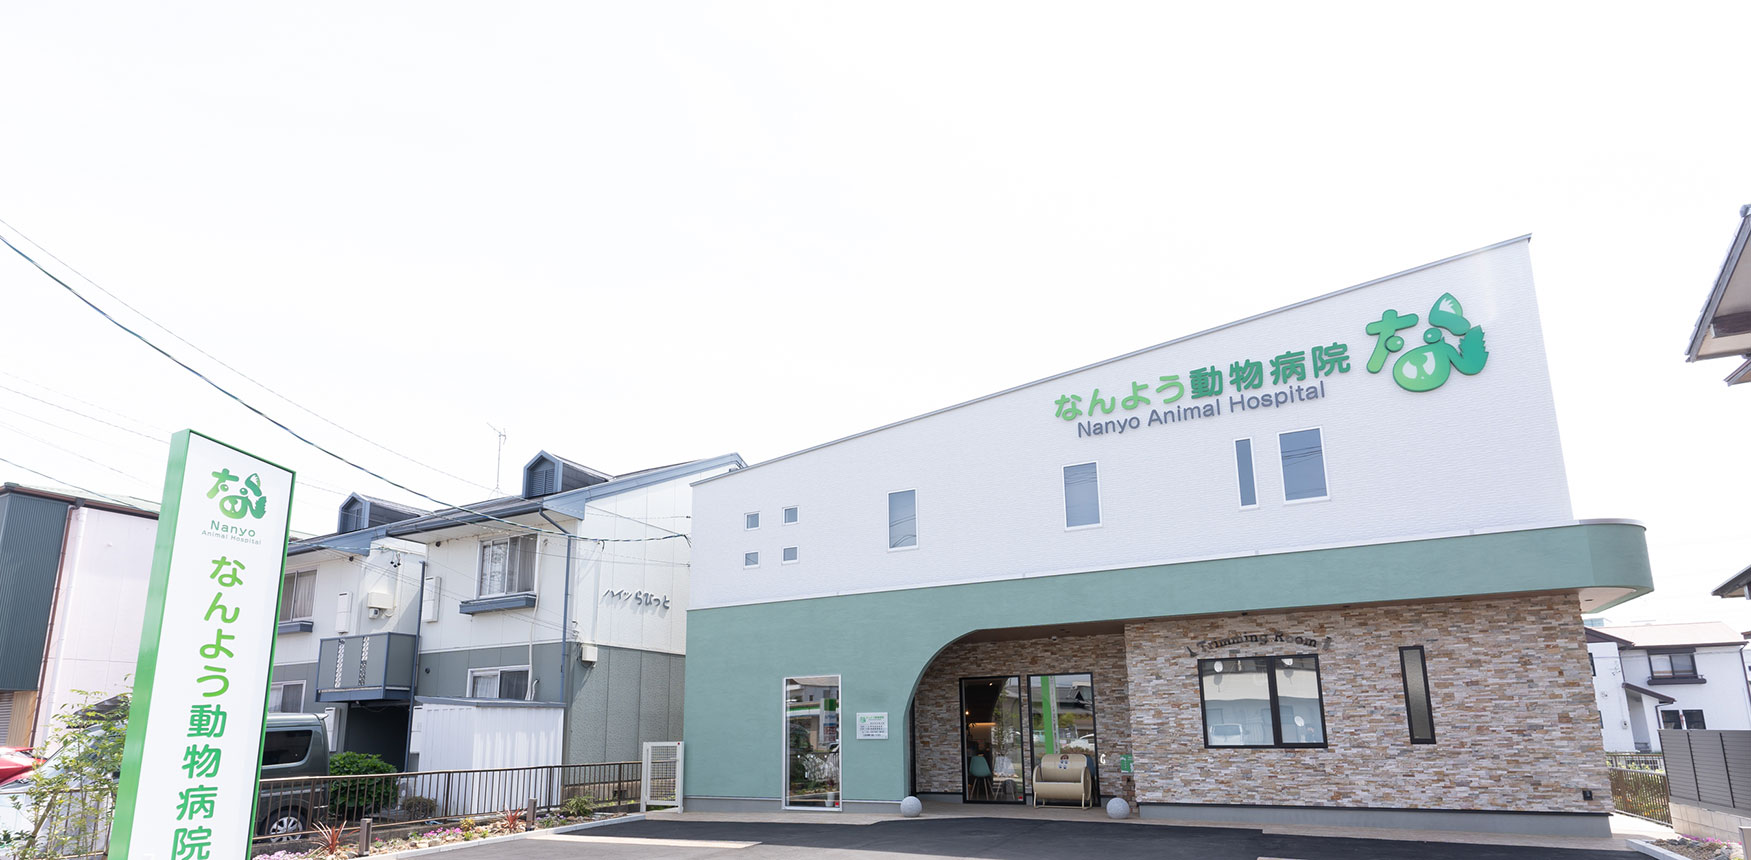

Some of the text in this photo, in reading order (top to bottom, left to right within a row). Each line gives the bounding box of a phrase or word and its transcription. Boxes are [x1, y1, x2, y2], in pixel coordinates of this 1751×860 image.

[1054, 341, 1352, 422] なんよう動物病院
[1077, 380, 1326, 439] Nanyo Animal Hospital
[201, 529, 262, 545] Animal Hospital
[210, 519, 256, 537] Nanyo
[1196, 630, 1318, 653] Trimming Room
[170, 555, 245, 860] なんよう動物病院
